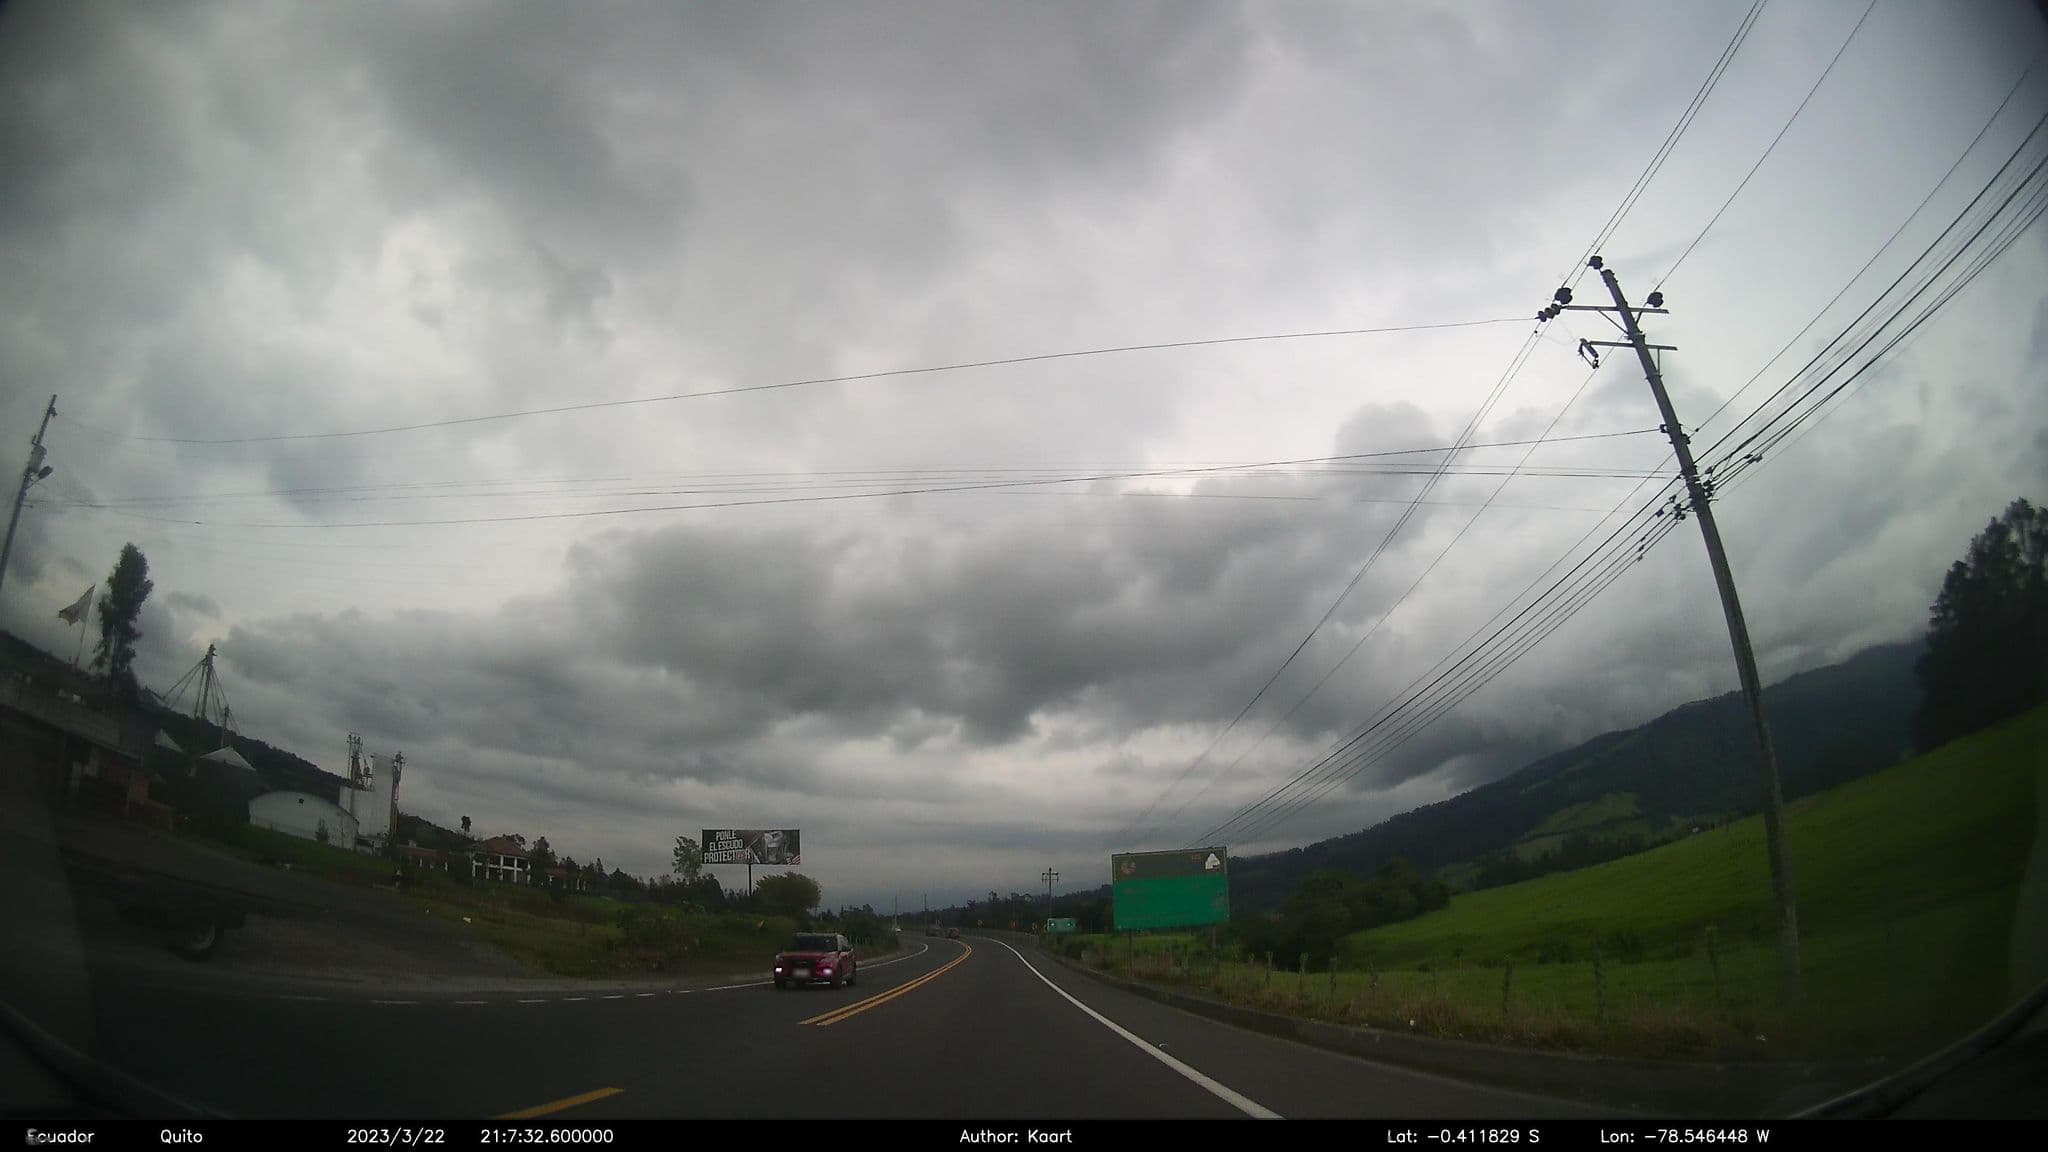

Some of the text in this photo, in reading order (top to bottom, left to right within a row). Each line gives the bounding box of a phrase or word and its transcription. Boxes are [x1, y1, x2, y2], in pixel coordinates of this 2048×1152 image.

[715, 831, 737, 841] PONLE
[709, 839, 743, 852] EL ESCUDO
